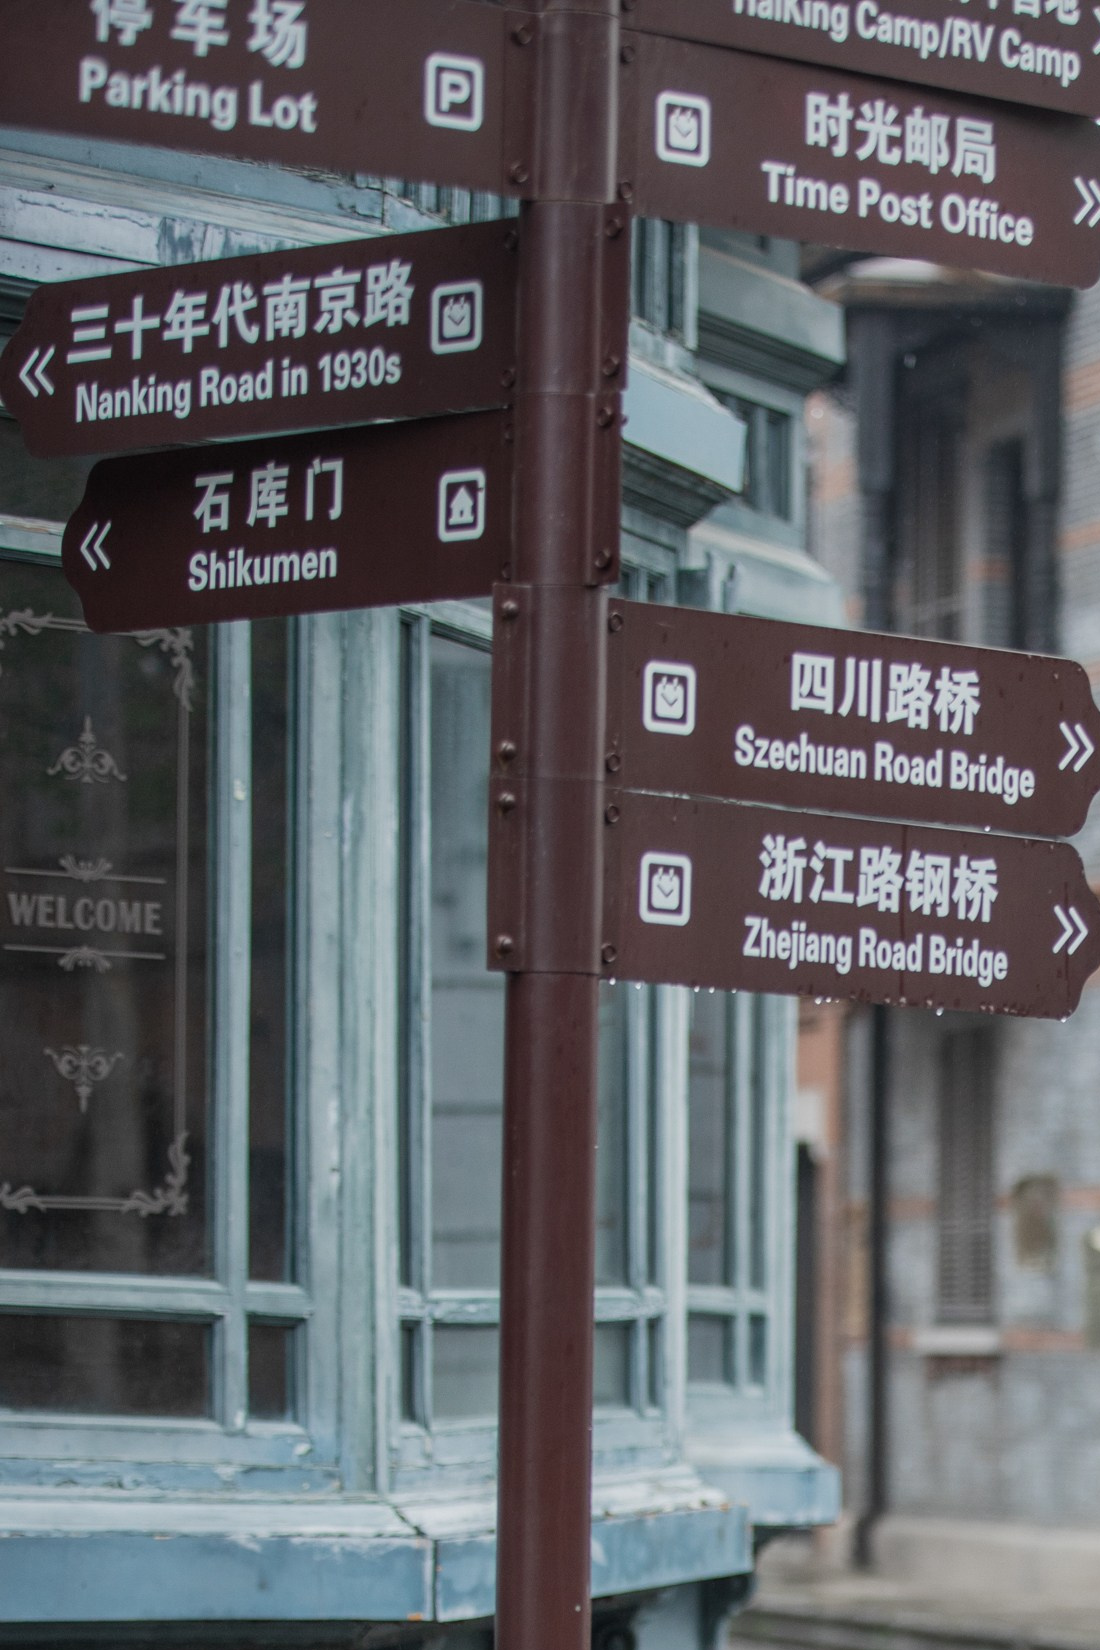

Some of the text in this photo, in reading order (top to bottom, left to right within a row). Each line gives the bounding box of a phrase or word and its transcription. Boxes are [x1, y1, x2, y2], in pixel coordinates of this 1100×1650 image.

[856, 0, 995, 62] Camp/RV
[999, 28, 1080, 87] Camp
[79, 57, 317, 132] Parking Lot
[440, 71, 470, 111] P
[806, 92, 995, 183] 时光邮局
[761, 161, 1033, 246] Time Post Office
[67, 260, 415, 364] 三十年代南京路
[76, 347, 401, 422] Nanking Road in 1930s
[194, 458, 343, 533] 石库门
[189, 548, 337, 591] Shikumen
[791, 653, 980, 735] 四川路桥
[735, 725, 1035, 804] Szechuan Road Bridge
[8, 893, 163, 935] WELCOME
[759, 834, 998, 922] 浙江路钢桥
[743, 916, 1008, 987] Zhejiang Road Bridge
